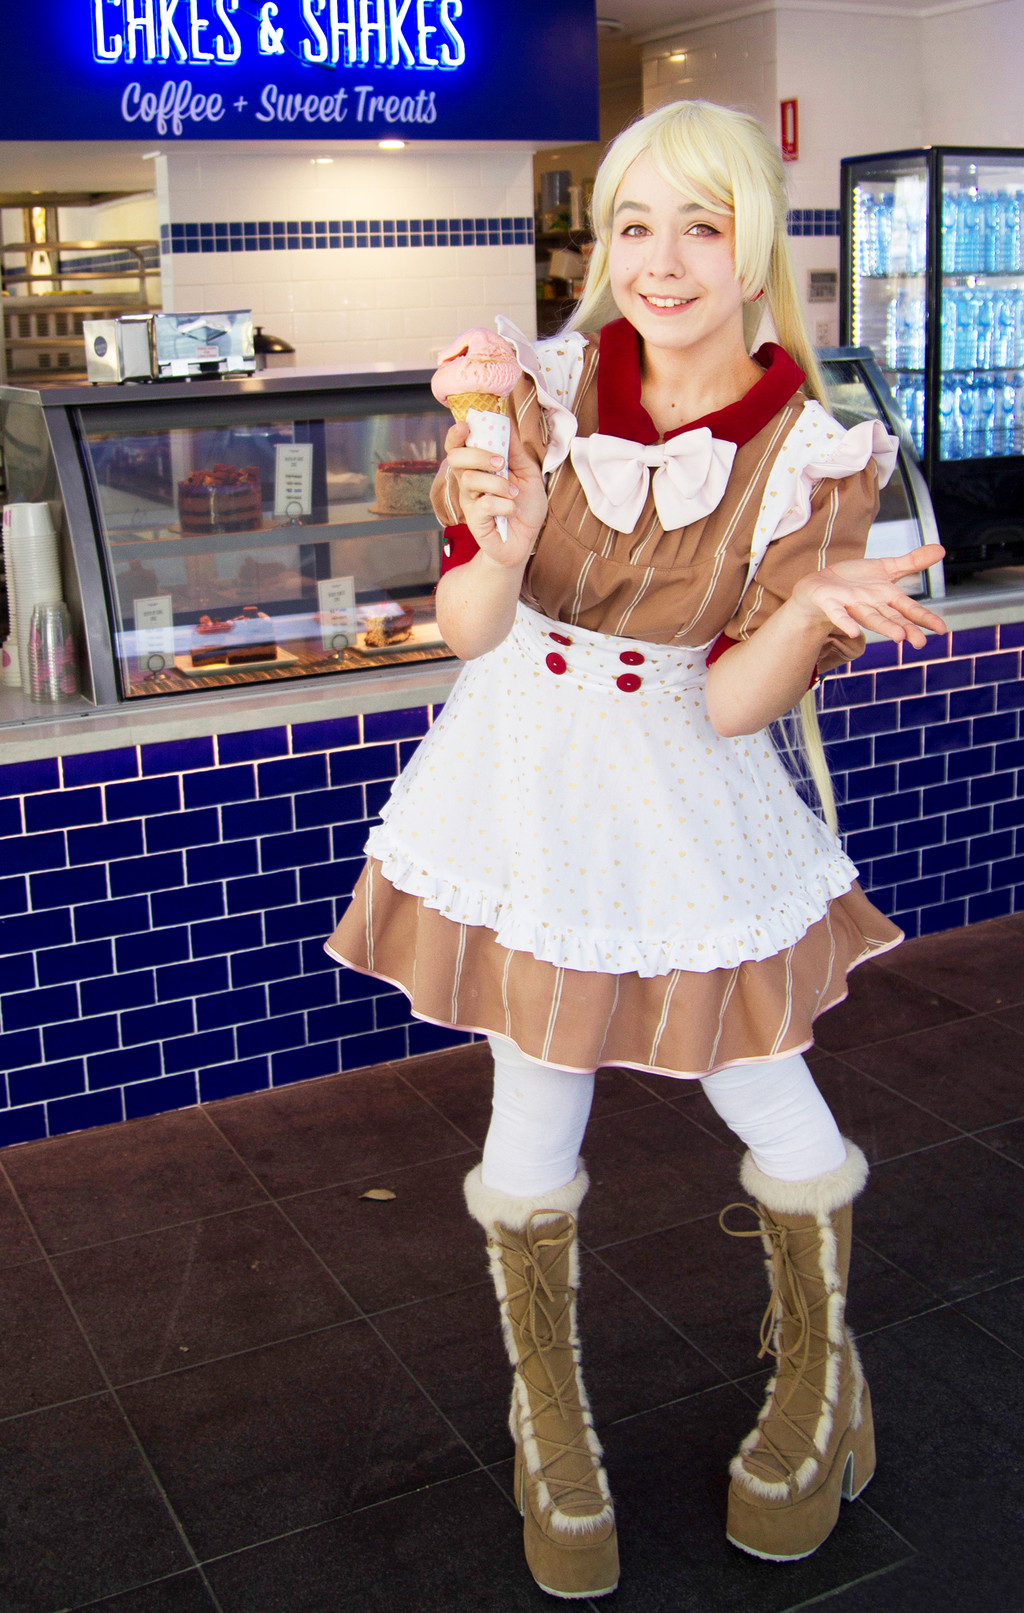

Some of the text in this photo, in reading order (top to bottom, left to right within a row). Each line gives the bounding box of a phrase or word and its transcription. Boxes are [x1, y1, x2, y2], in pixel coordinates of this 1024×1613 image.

[91, 0, 466, 70] CAKES & SHAKES
[121, 79, 438, 136] Coffee + Sweet Treats
